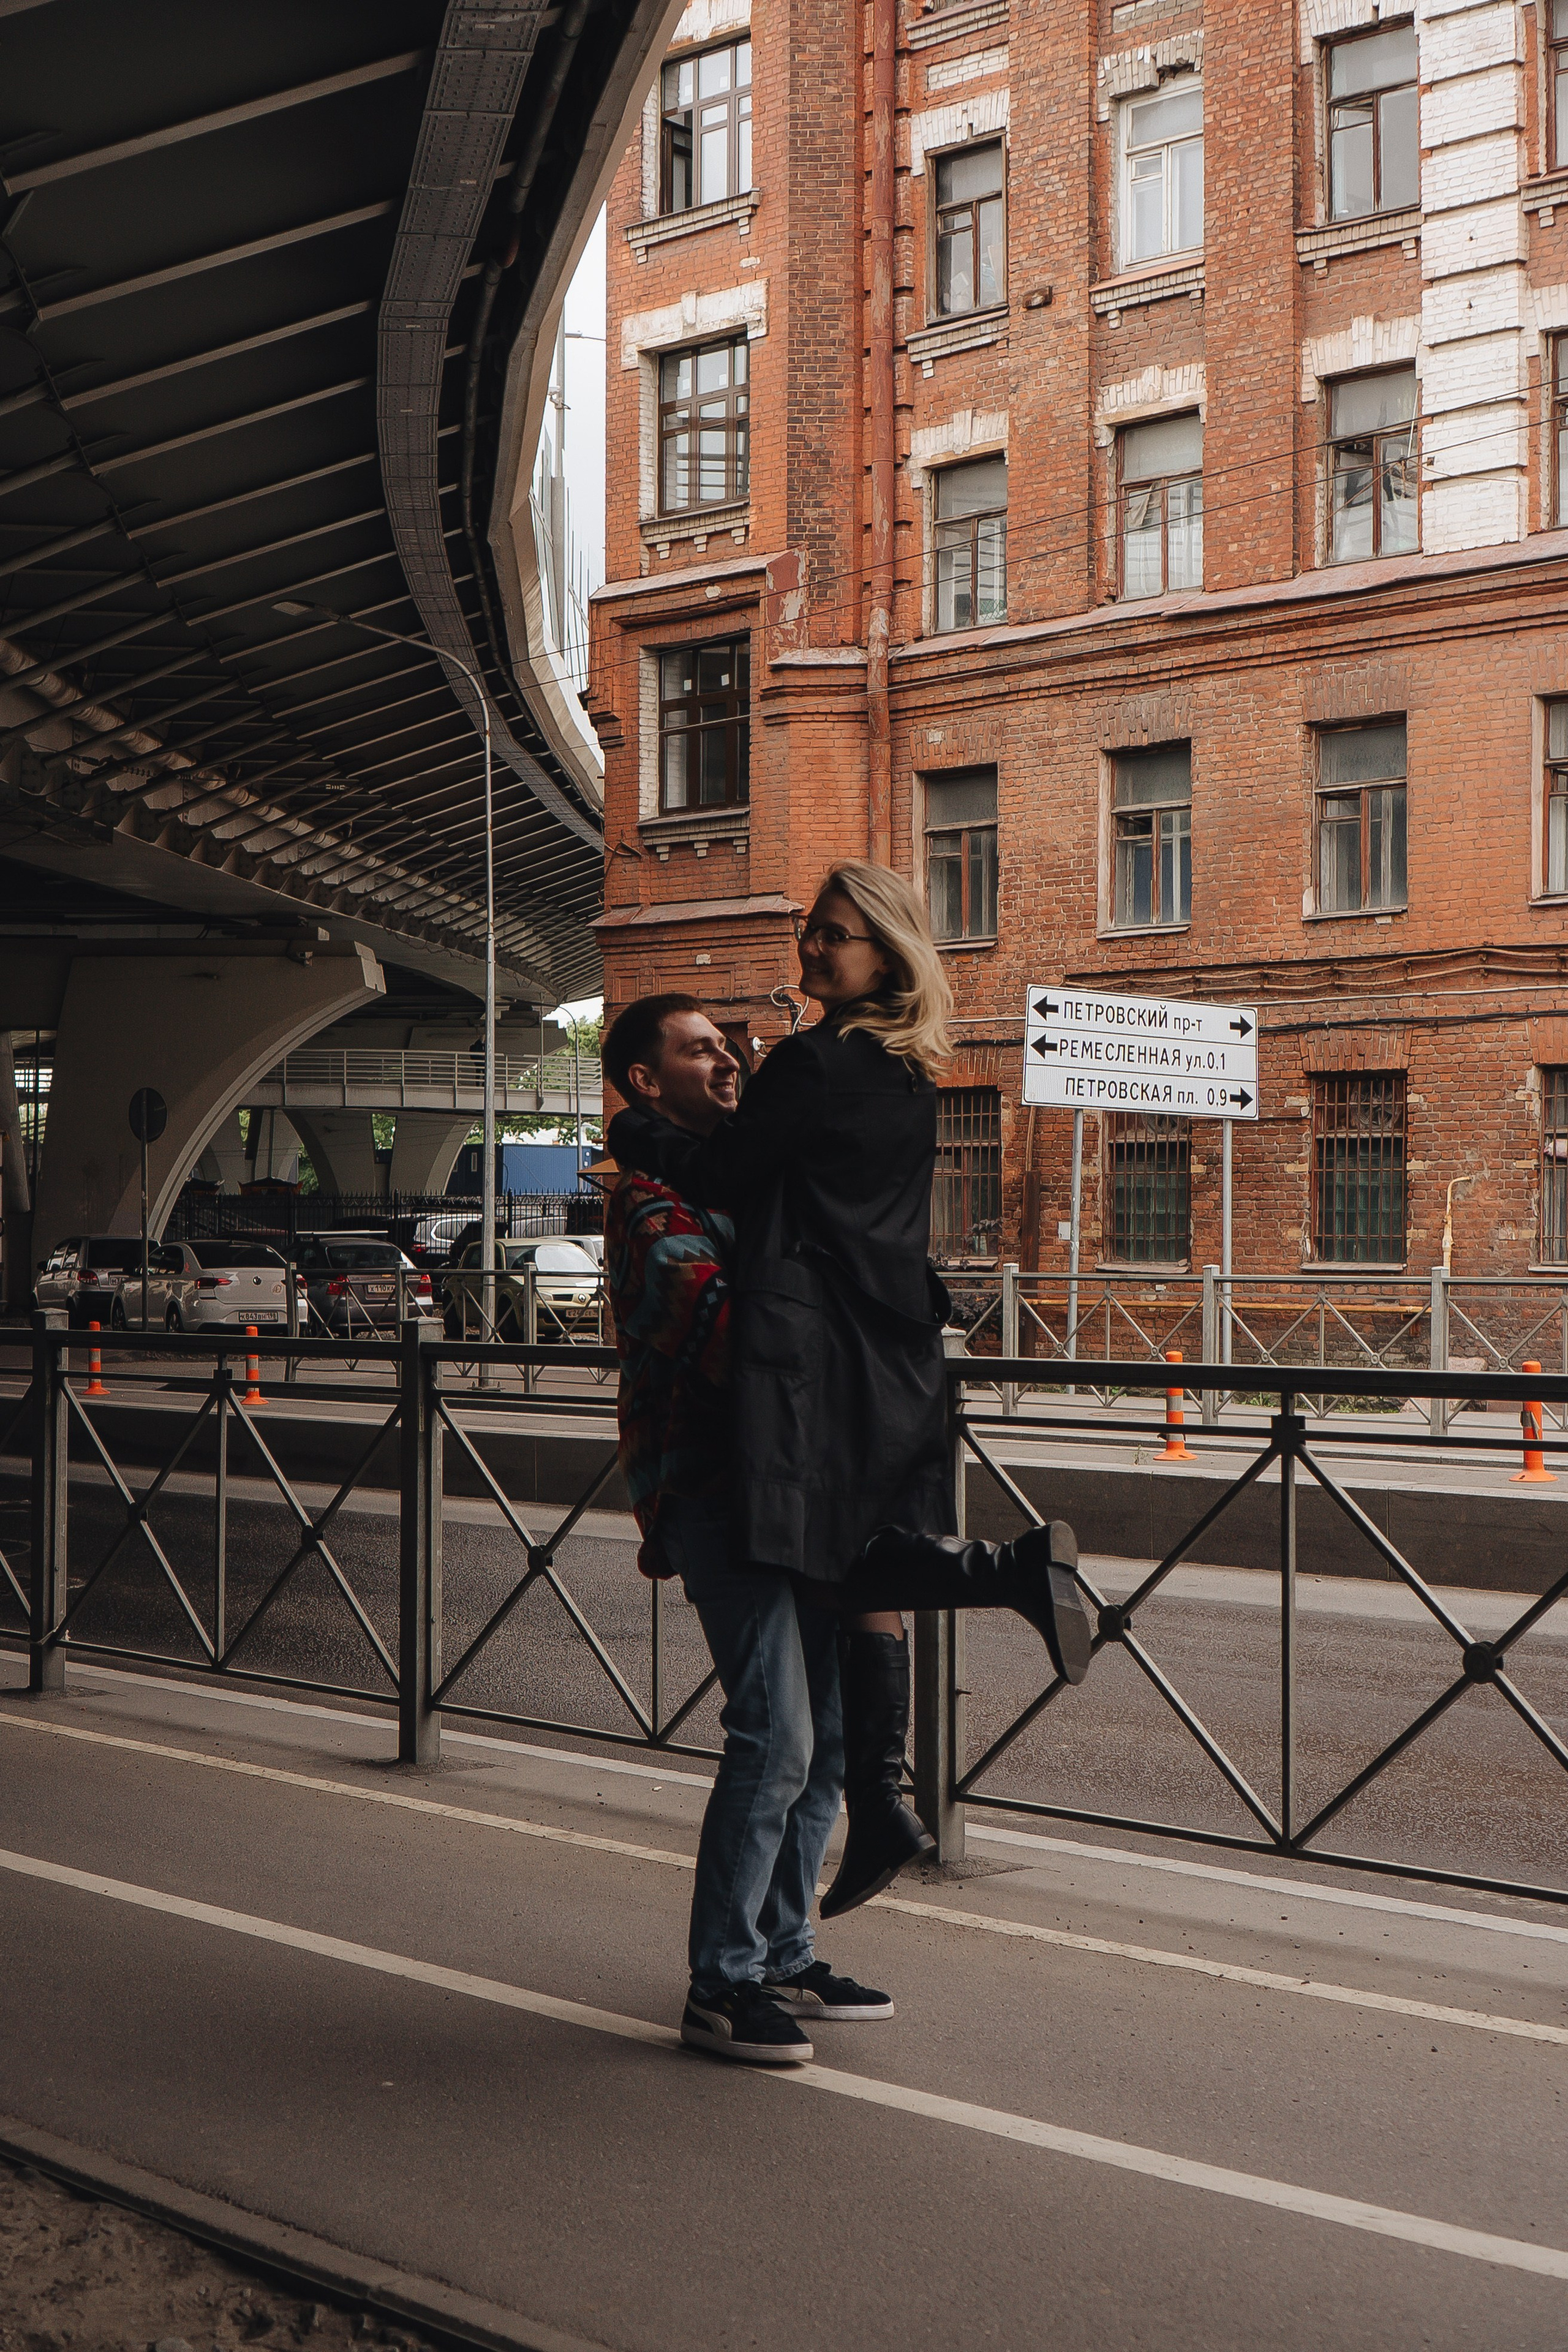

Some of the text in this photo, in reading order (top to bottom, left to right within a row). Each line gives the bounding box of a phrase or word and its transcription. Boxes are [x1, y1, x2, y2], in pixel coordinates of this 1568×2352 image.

[1063, 1001, 1202, 1036] ПЕТРОВСКИЙ пр-т
[1060, 1038, 1180, 1066] РЕМЕСЛЕННАЯ
[1065, 1077, 1227, 1107] ПЕТРОВСКАЯ пл. 0,9
